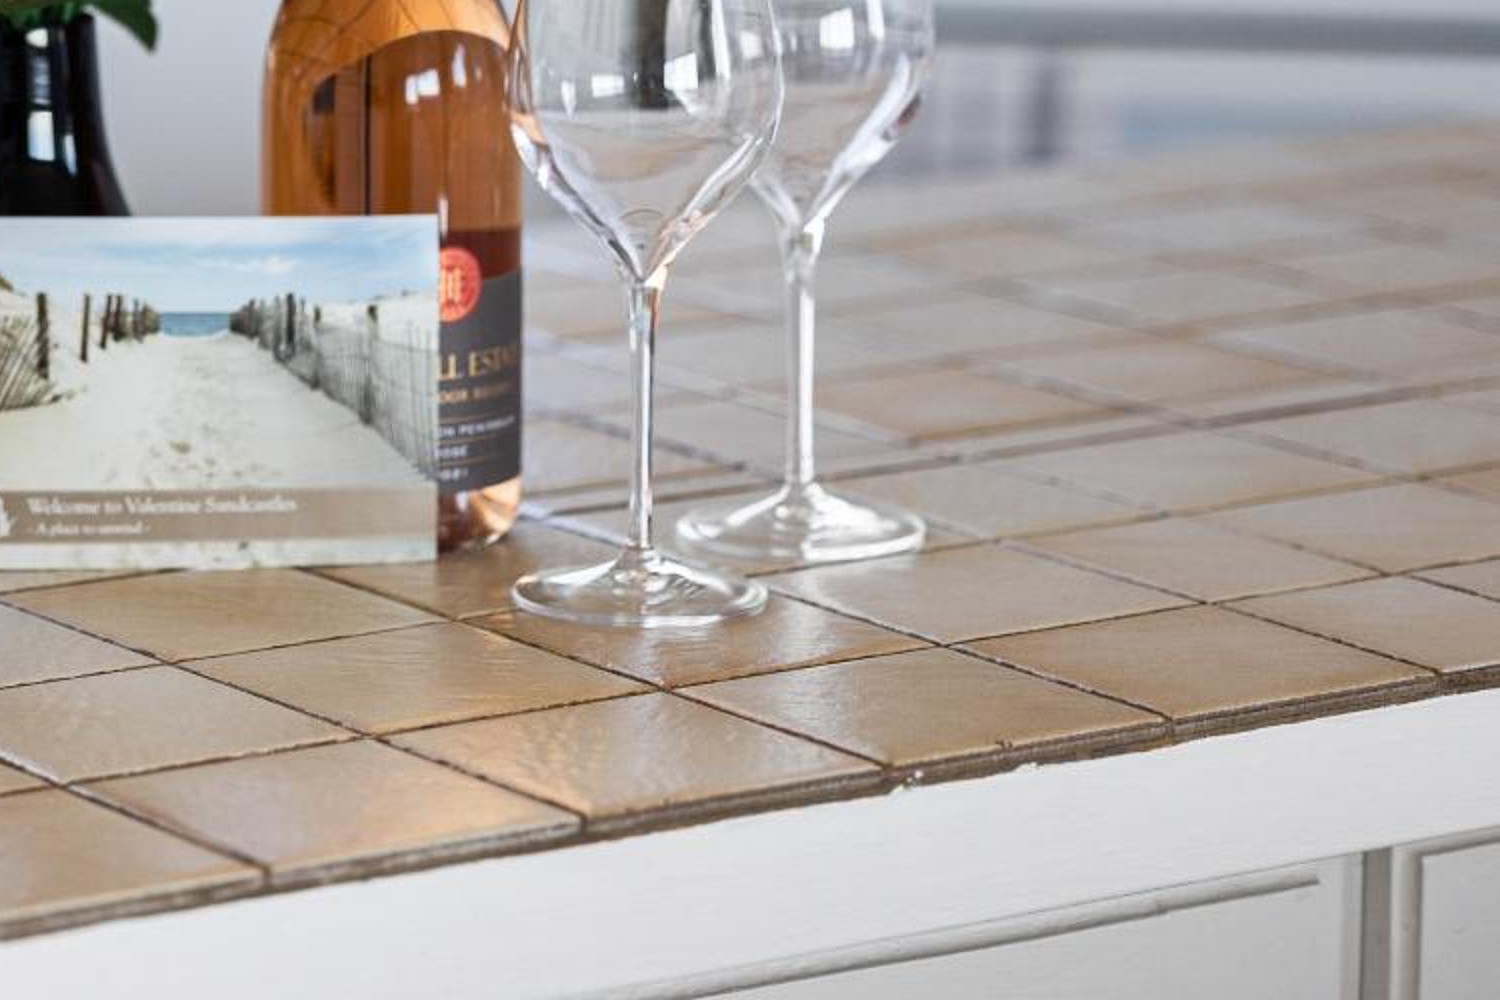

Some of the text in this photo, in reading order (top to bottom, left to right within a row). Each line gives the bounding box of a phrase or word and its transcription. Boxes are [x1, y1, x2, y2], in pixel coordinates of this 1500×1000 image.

[26, 496, 100, 516] Welcome
[104, 499, 122, 515] to
[125, 496, 201, 515] Valentine
